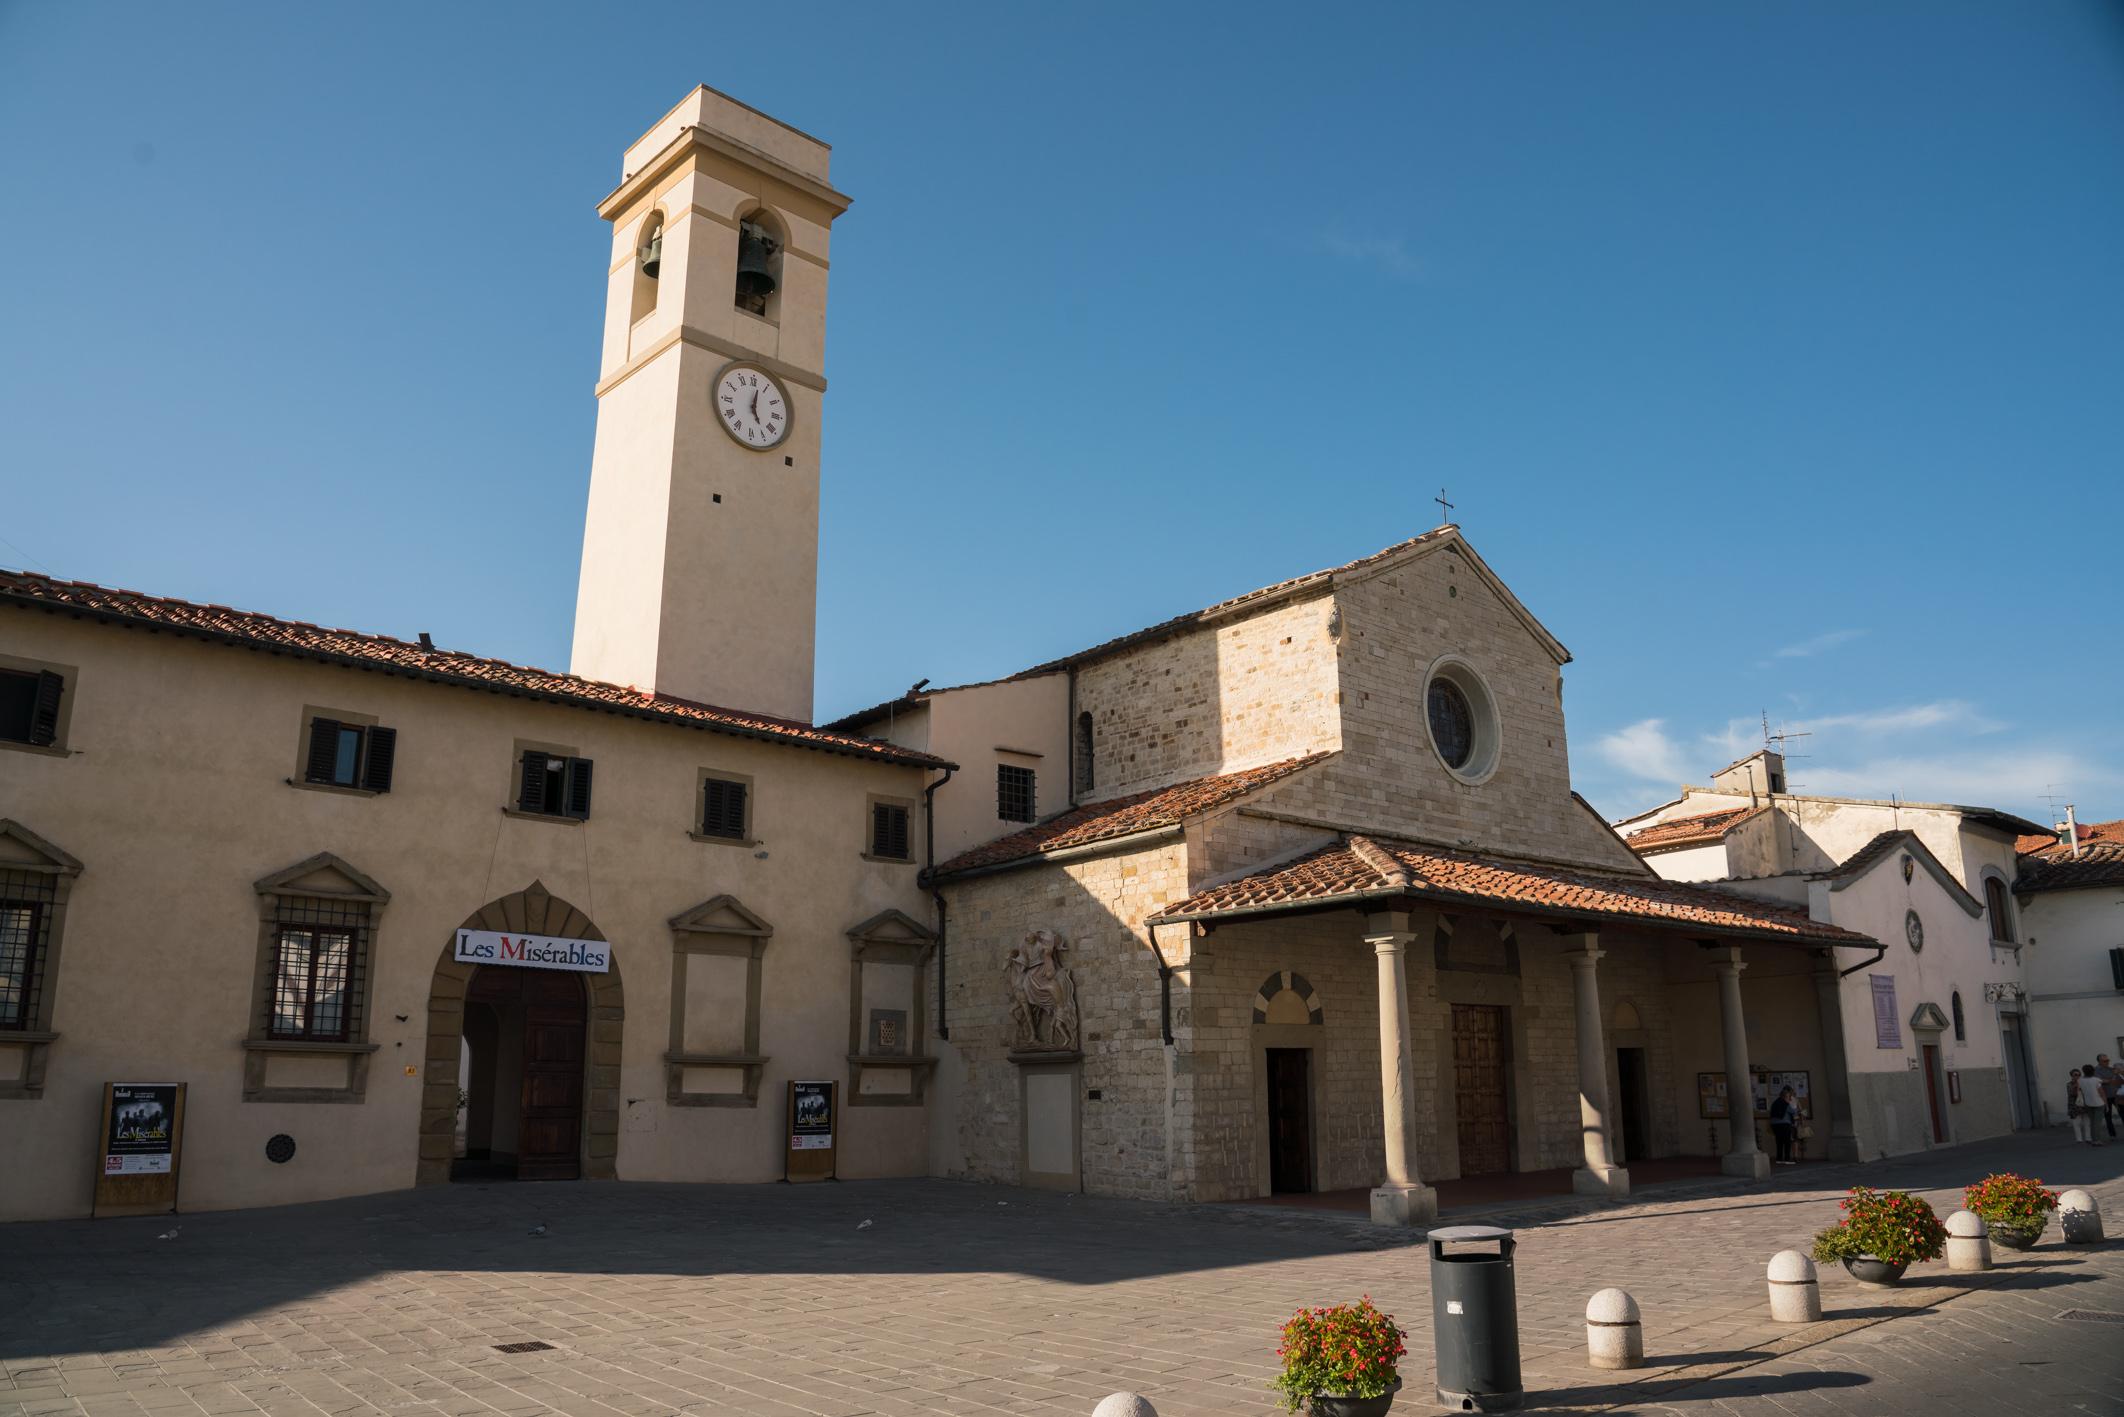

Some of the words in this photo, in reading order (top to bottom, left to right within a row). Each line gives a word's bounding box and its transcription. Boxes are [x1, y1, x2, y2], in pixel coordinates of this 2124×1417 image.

[728, 383, 737, 392] X
[459, 934, 494, 958] Les
[499, 937, 604, 966] Misérables
[117, 1127, 129, 1139] Les
[130, 1127, 166, 1139] Misérables
